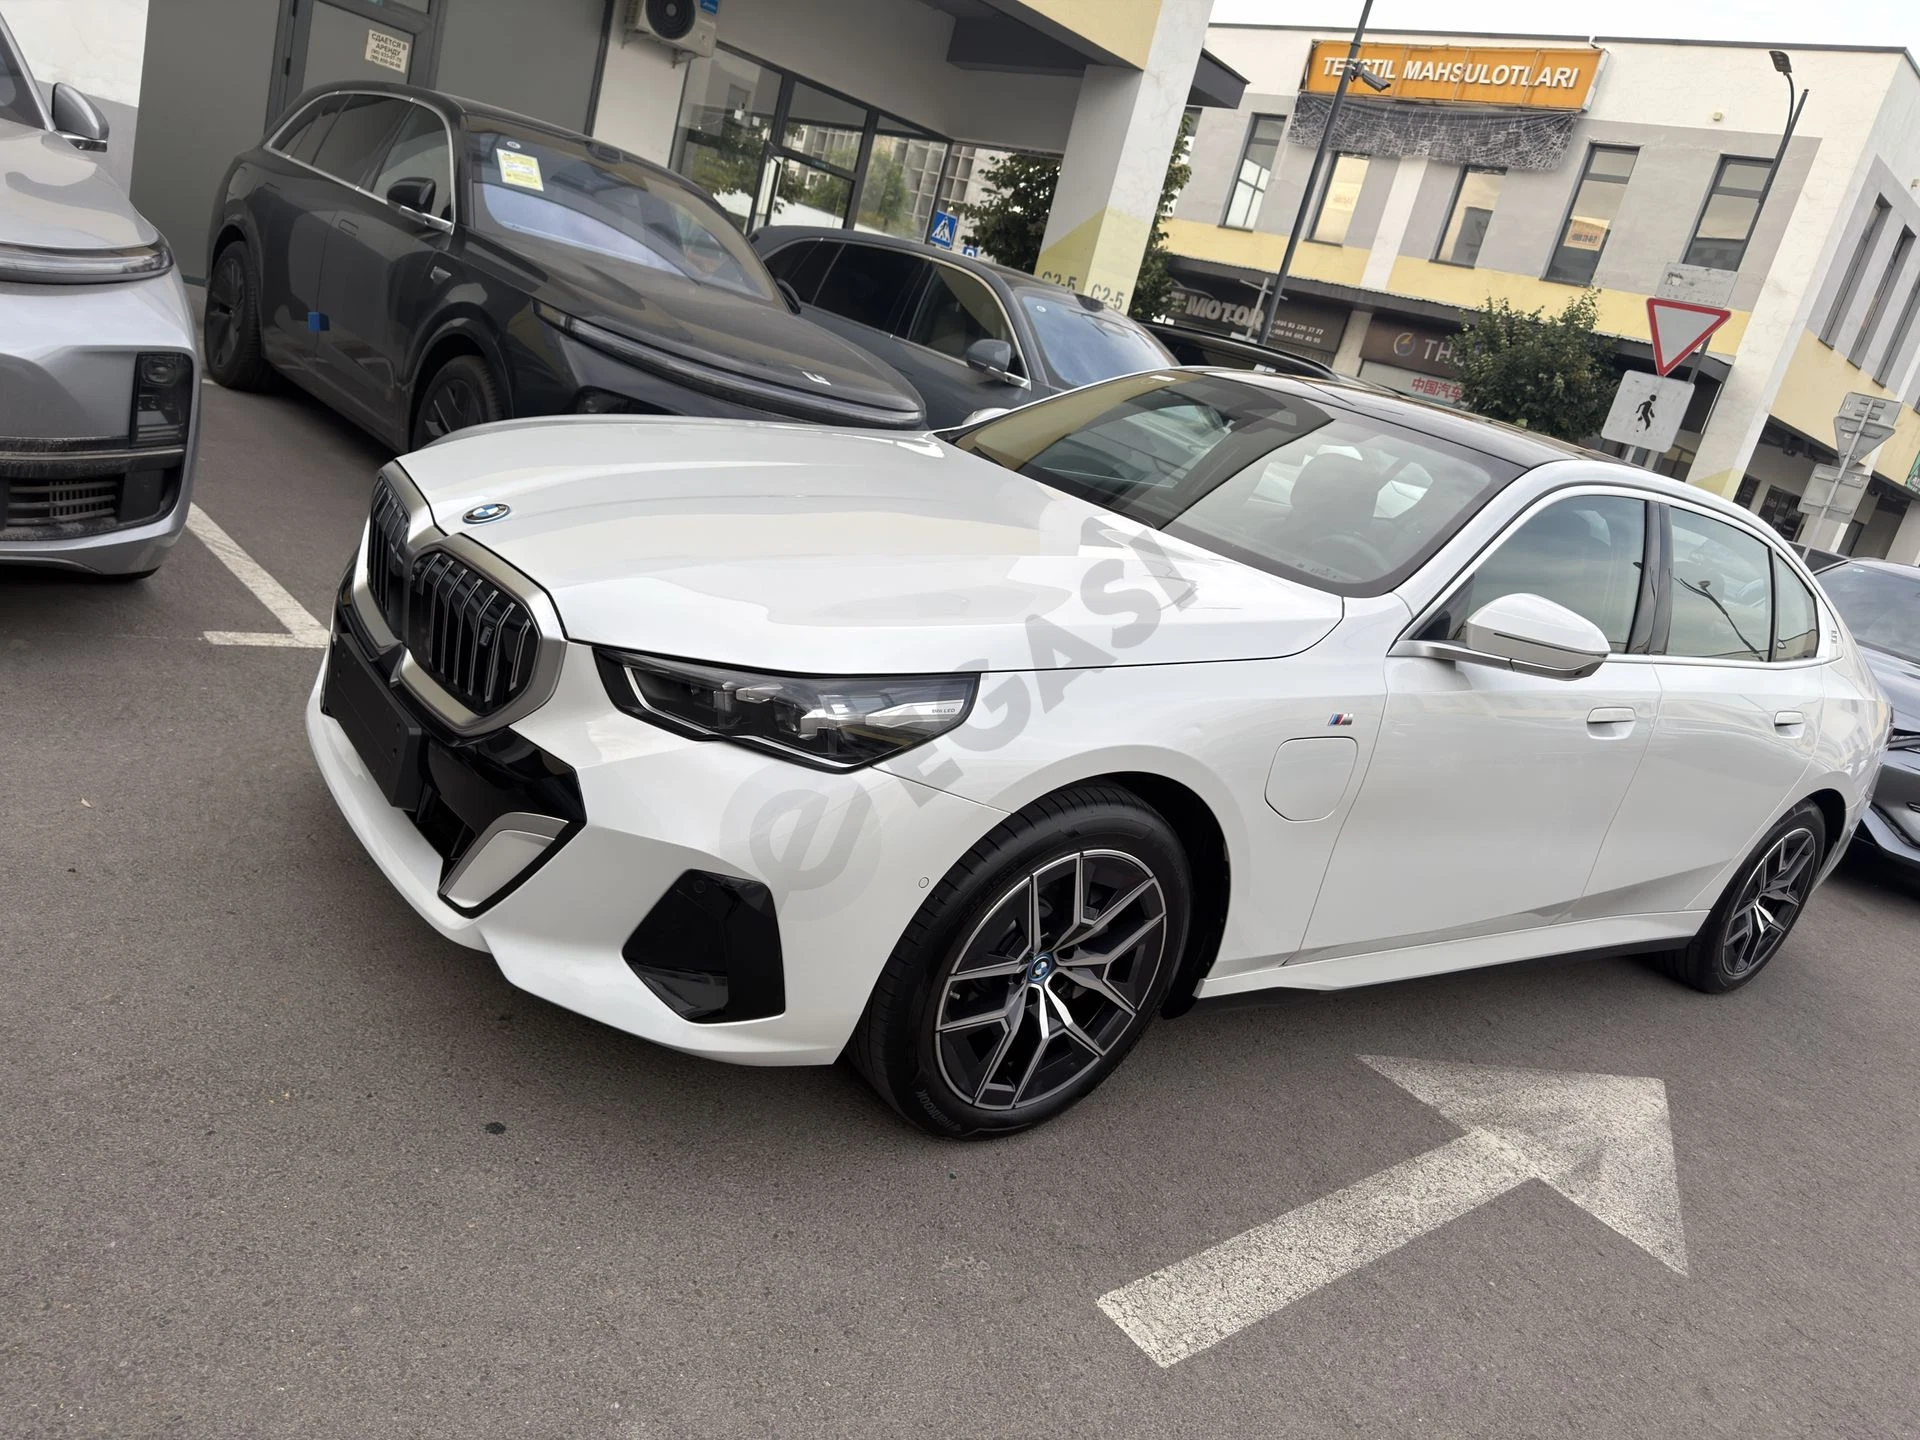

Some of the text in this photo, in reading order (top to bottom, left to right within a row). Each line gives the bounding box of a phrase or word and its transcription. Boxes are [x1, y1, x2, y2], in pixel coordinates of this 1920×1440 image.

[371, 33, 401, 48] СДАЕТСЯ
[375, 43, 401, 56] АРЕНДУ
[1323, 56, 1580, 89] TESTIL MAHSULOTLARI
[1090, 283, 1125, 310] C2-5
[1184, 295, 1264, 331] MOTOR
